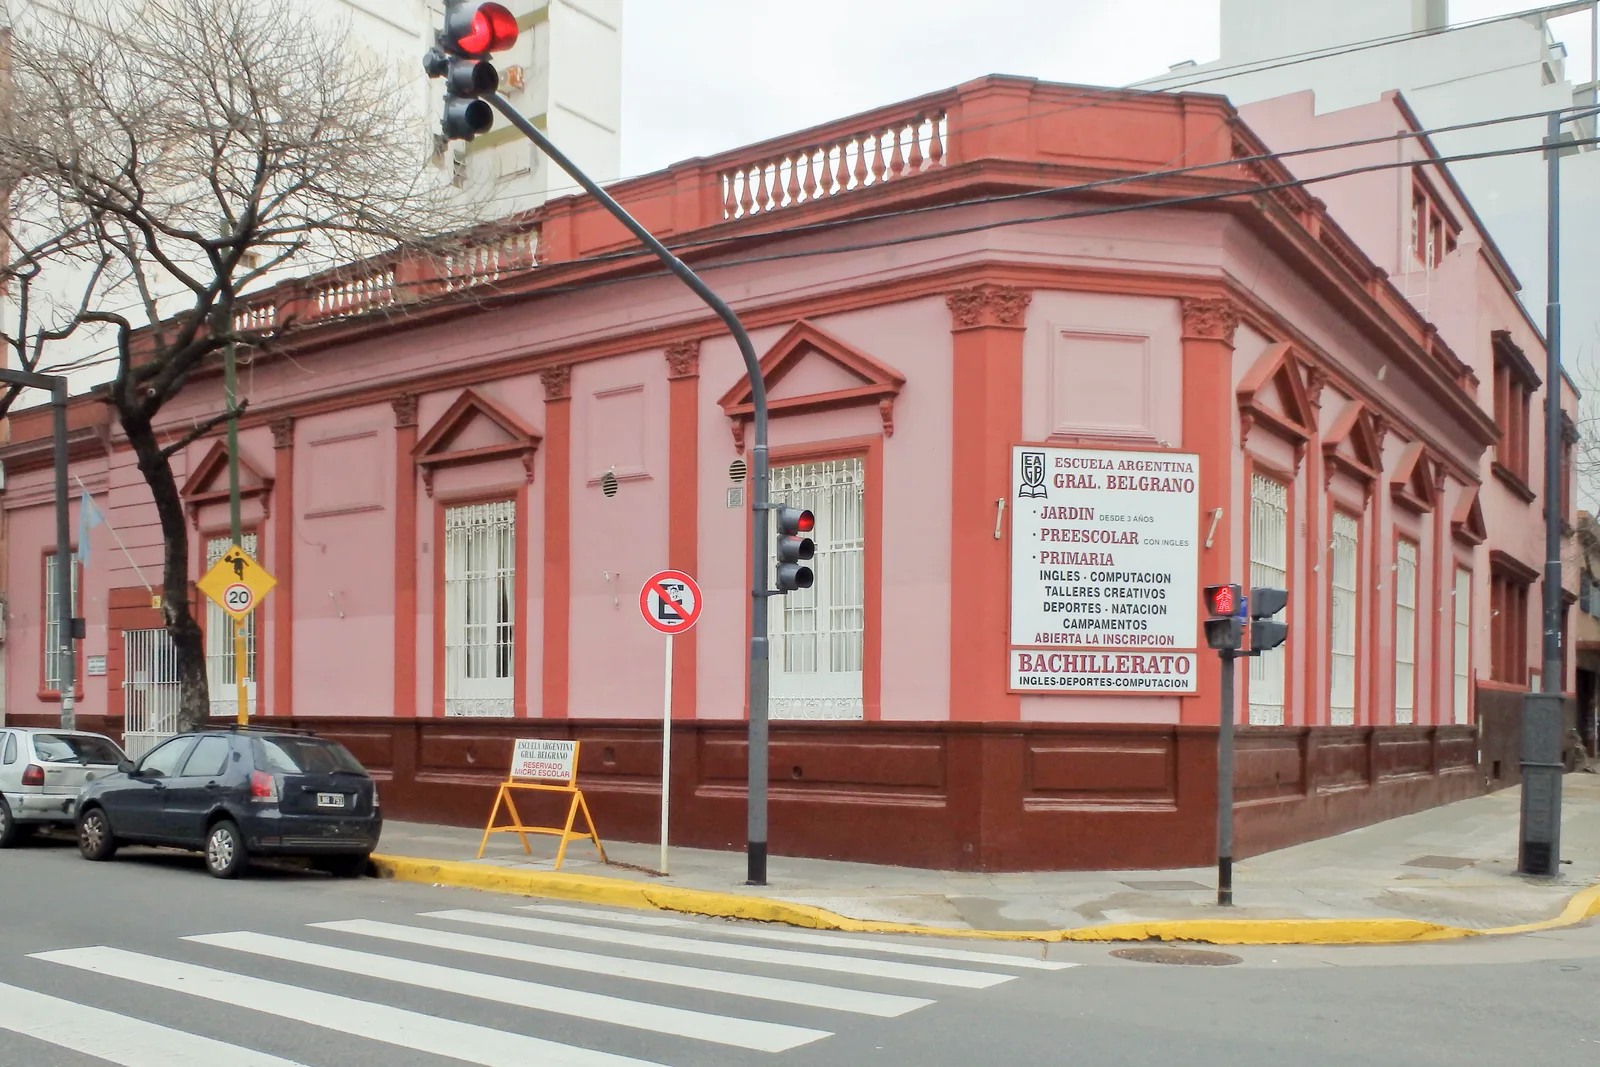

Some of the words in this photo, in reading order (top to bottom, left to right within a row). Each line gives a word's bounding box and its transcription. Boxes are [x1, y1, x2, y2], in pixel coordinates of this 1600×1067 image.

[1025, 456, 1041, 465] EA
[1054, 457, 1114, 470] ESCUELA
[1117, 460, 1193, 473] ARGENTINA
[1053, 473, 1101, 490] GRAL.
[1106, 475, 1195, 494] BELGRANO
[1040, 506, 1095, 521] JARDIN
[1099, 514, 1125, 522] DESDE
[1133, 515, 1154, 523] AÑOS
[1040, 528, 1139, 545] PREESCOLAR
[1143, 538, 1160, 546] CON
[1040, 551, 1115, 567] PRIMARIA
[1040, 570, 1080, 582] INGLES
[1090, 571, 1171, 584] COMPUTACION
[229, 591, 249, 604] 20
[1045, 586, 1101, 598] TALLERES
[1104, 587, 1166, 600] CREATIVOS
[1043, 602, 1102, 614] DEPORTES
[1111, 604, 1167, 615] NATACION
[1063, 618, 1148, 631] CAMPAMENTOS
[1034, 633, 1082, 645] ABIERTA
[1085, 634, 1099, 645] LA
[1103, 635, 1175, 646] INSCRIPCION
[1018, 653, 1191, 675] BACHILLERATO
[518, 741, 541, 750] ESCUELA
[542, 742, 573, 751] ARGENTINA
[520, 750, 536, 759] GRAL.
[538, 751, 568, 760] BELGRANO
[523, 762, 562, 770] RESERVADO
